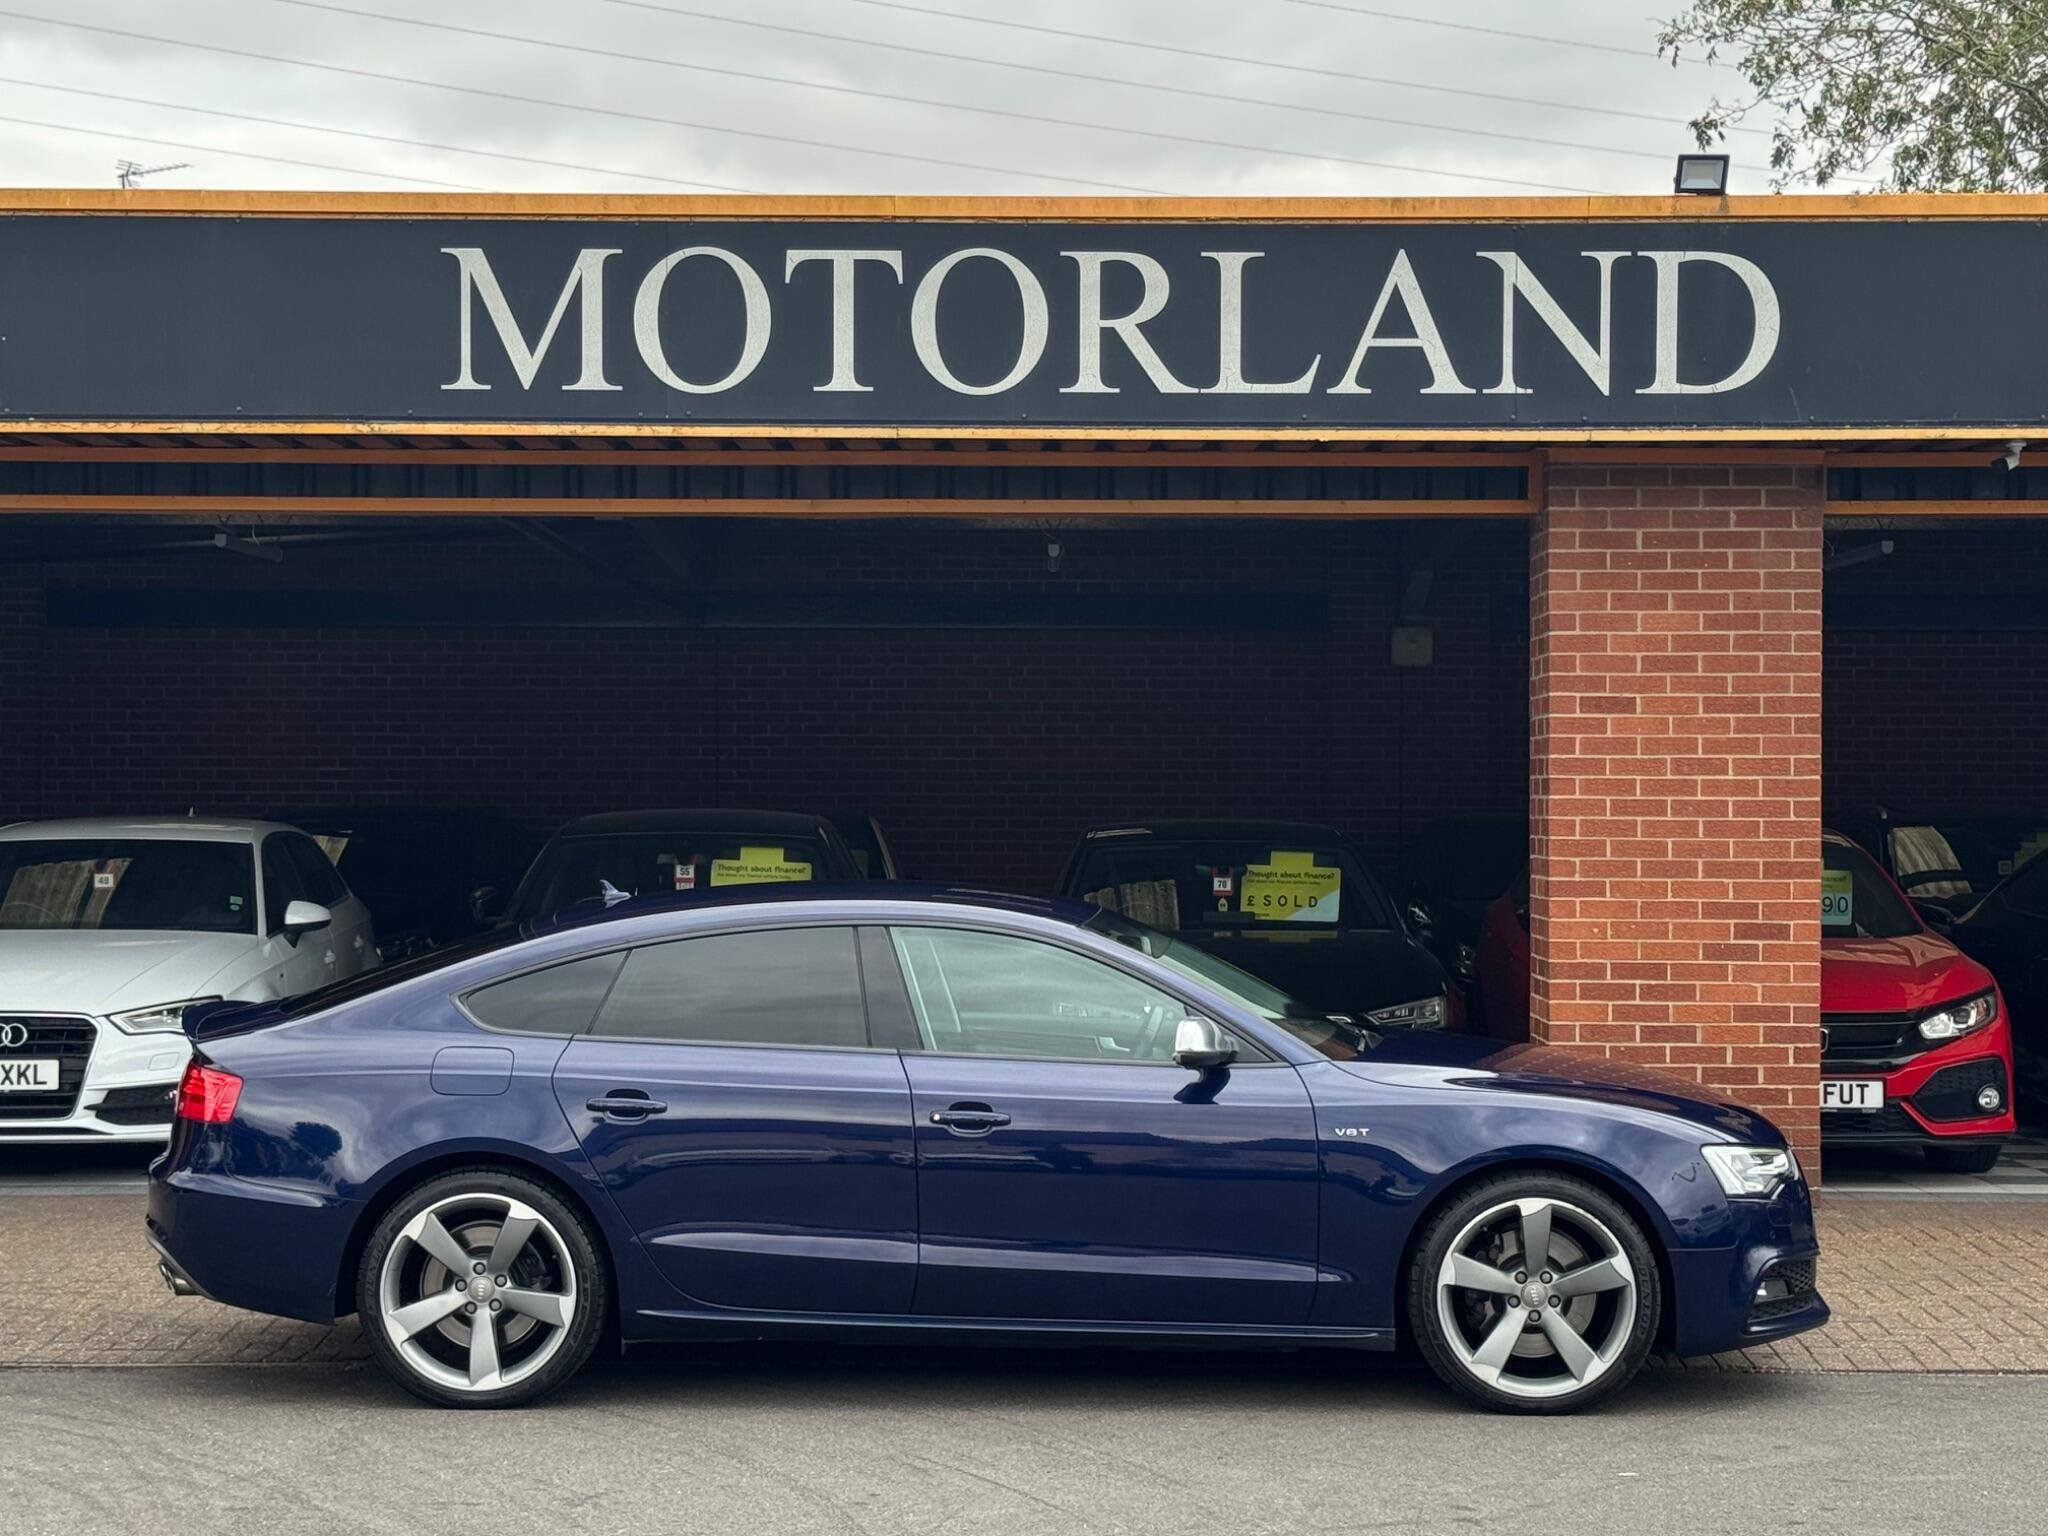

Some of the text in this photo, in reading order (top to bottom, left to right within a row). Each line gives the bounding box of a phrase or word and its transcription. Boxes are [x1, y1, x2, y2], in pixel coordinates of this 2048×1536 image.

[441, 247, 1781, 396] MOTORLAND
[750, 864, 772, 873] about
[1280, 871, 1301, 879] about
[0, 1064, 47, 1086] XKL
[1823, 1083, 1869, 1105] FUT
